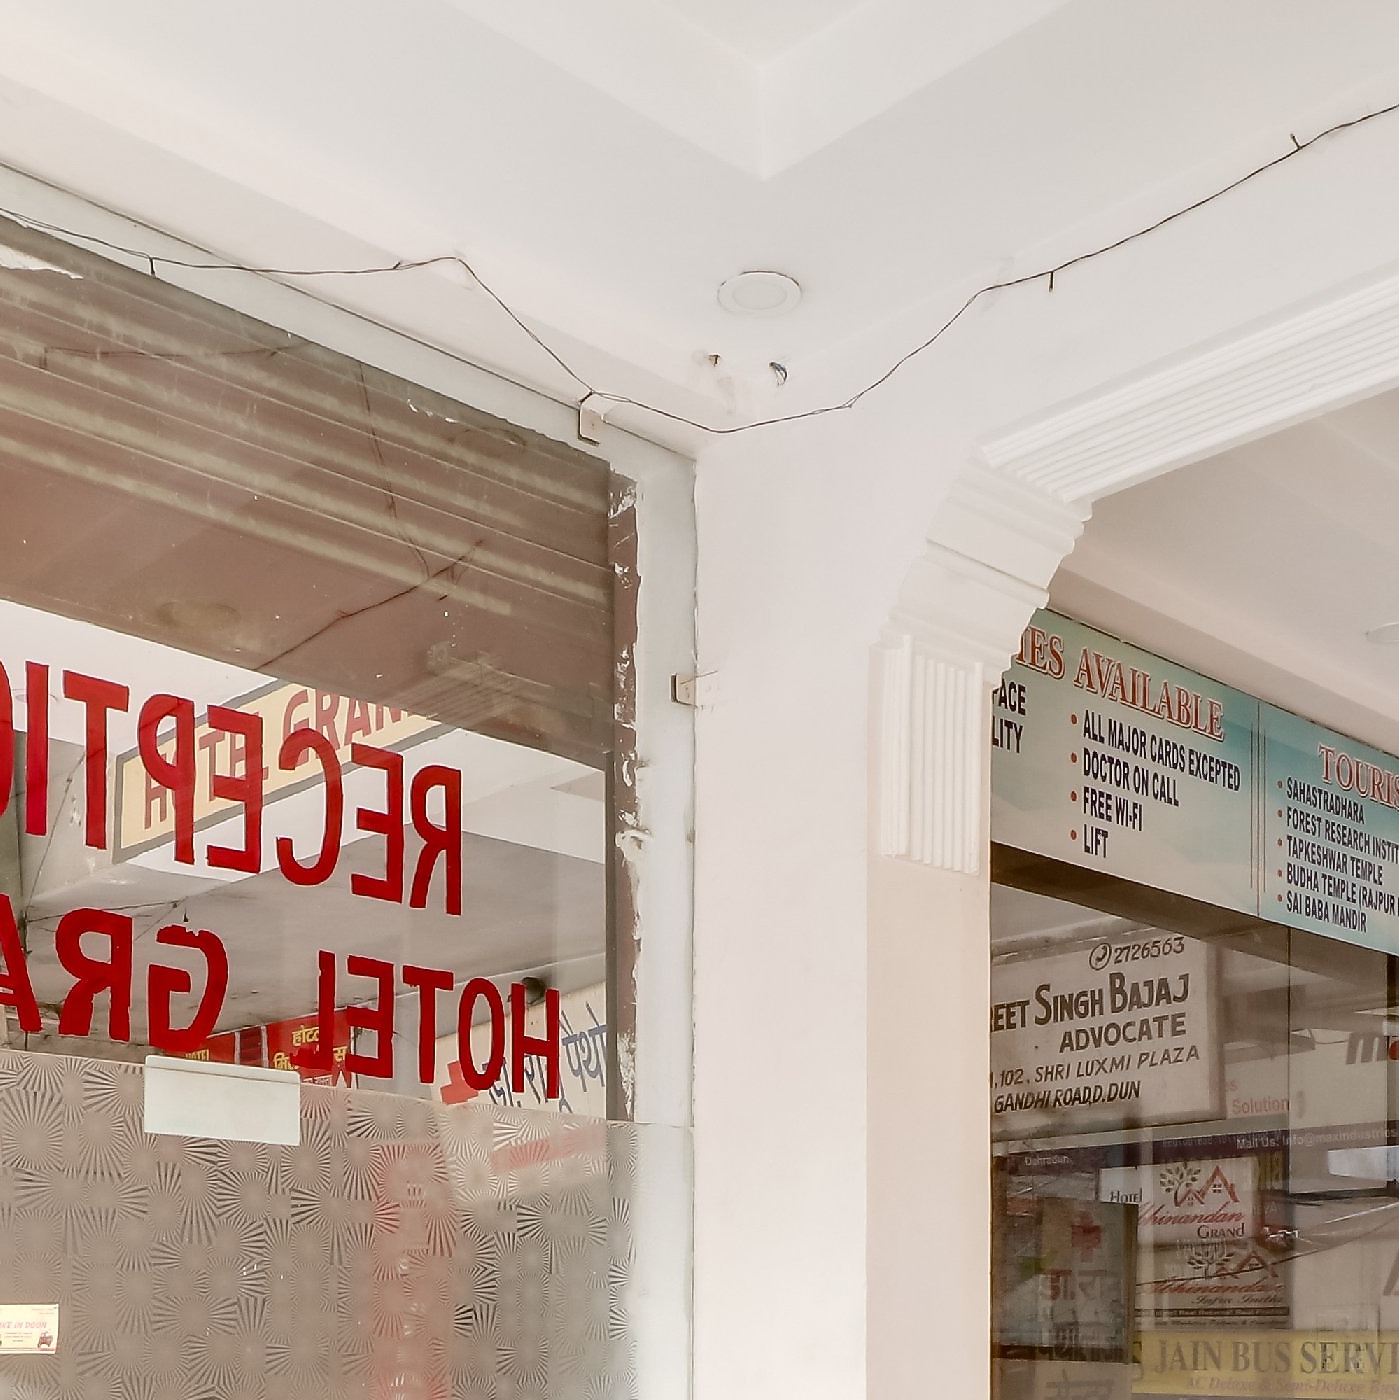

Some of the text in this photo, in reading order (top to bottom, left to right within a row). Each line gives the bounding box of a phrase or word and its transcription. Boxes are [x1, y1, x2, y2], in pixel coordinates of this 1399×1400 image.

[1074, 647, 1224, 742] AVAILABLE
[1083, 710, 1240, 791] ALL MAJOR CARDS EXCEPTED
[1083, 748, 1179, 807] DOCTOR ON CALL
[1286, 776, 1365, 825] SAHASTRADHARA
[1083, 786, 1143, 832] FREE WI-FI
[1286, 806, 1322, 839] FOREST
[1324, 819, 1370, 854] RESEARCH
[1083, 823, 1109, 858] LIFT
[1286, 836, 1383, 886] TAPKESHWAR TEMPLE
[1286, 862, 1319, 893] BUDHA
[1321, 874, 1357, 904] TEMPLE
[1358, 885, 1395, 918] (RAJPUR
[1286, 890, 1367, 933] SAI BABA MANDIR
[1113, 937, 1185, 965] 2726563
[1034, 984, 1104, 1026] SINGH
[1108, 972, 1190, 1014] BAJAJ
[1059, 1012, 1187, 1054] ADVOCATE
[1035, 1063, 1071, 1084] SHRI
[1076, 1054, 1131, 1079] LUXMI
[1137, 1045, 1200, 1069] PLAZA
[994, 1089, 1050, 1114] GANDHI
[1154, 1339, 1223, 1373] JAIN
[1231, 1340, 1291, 1374] BUS
